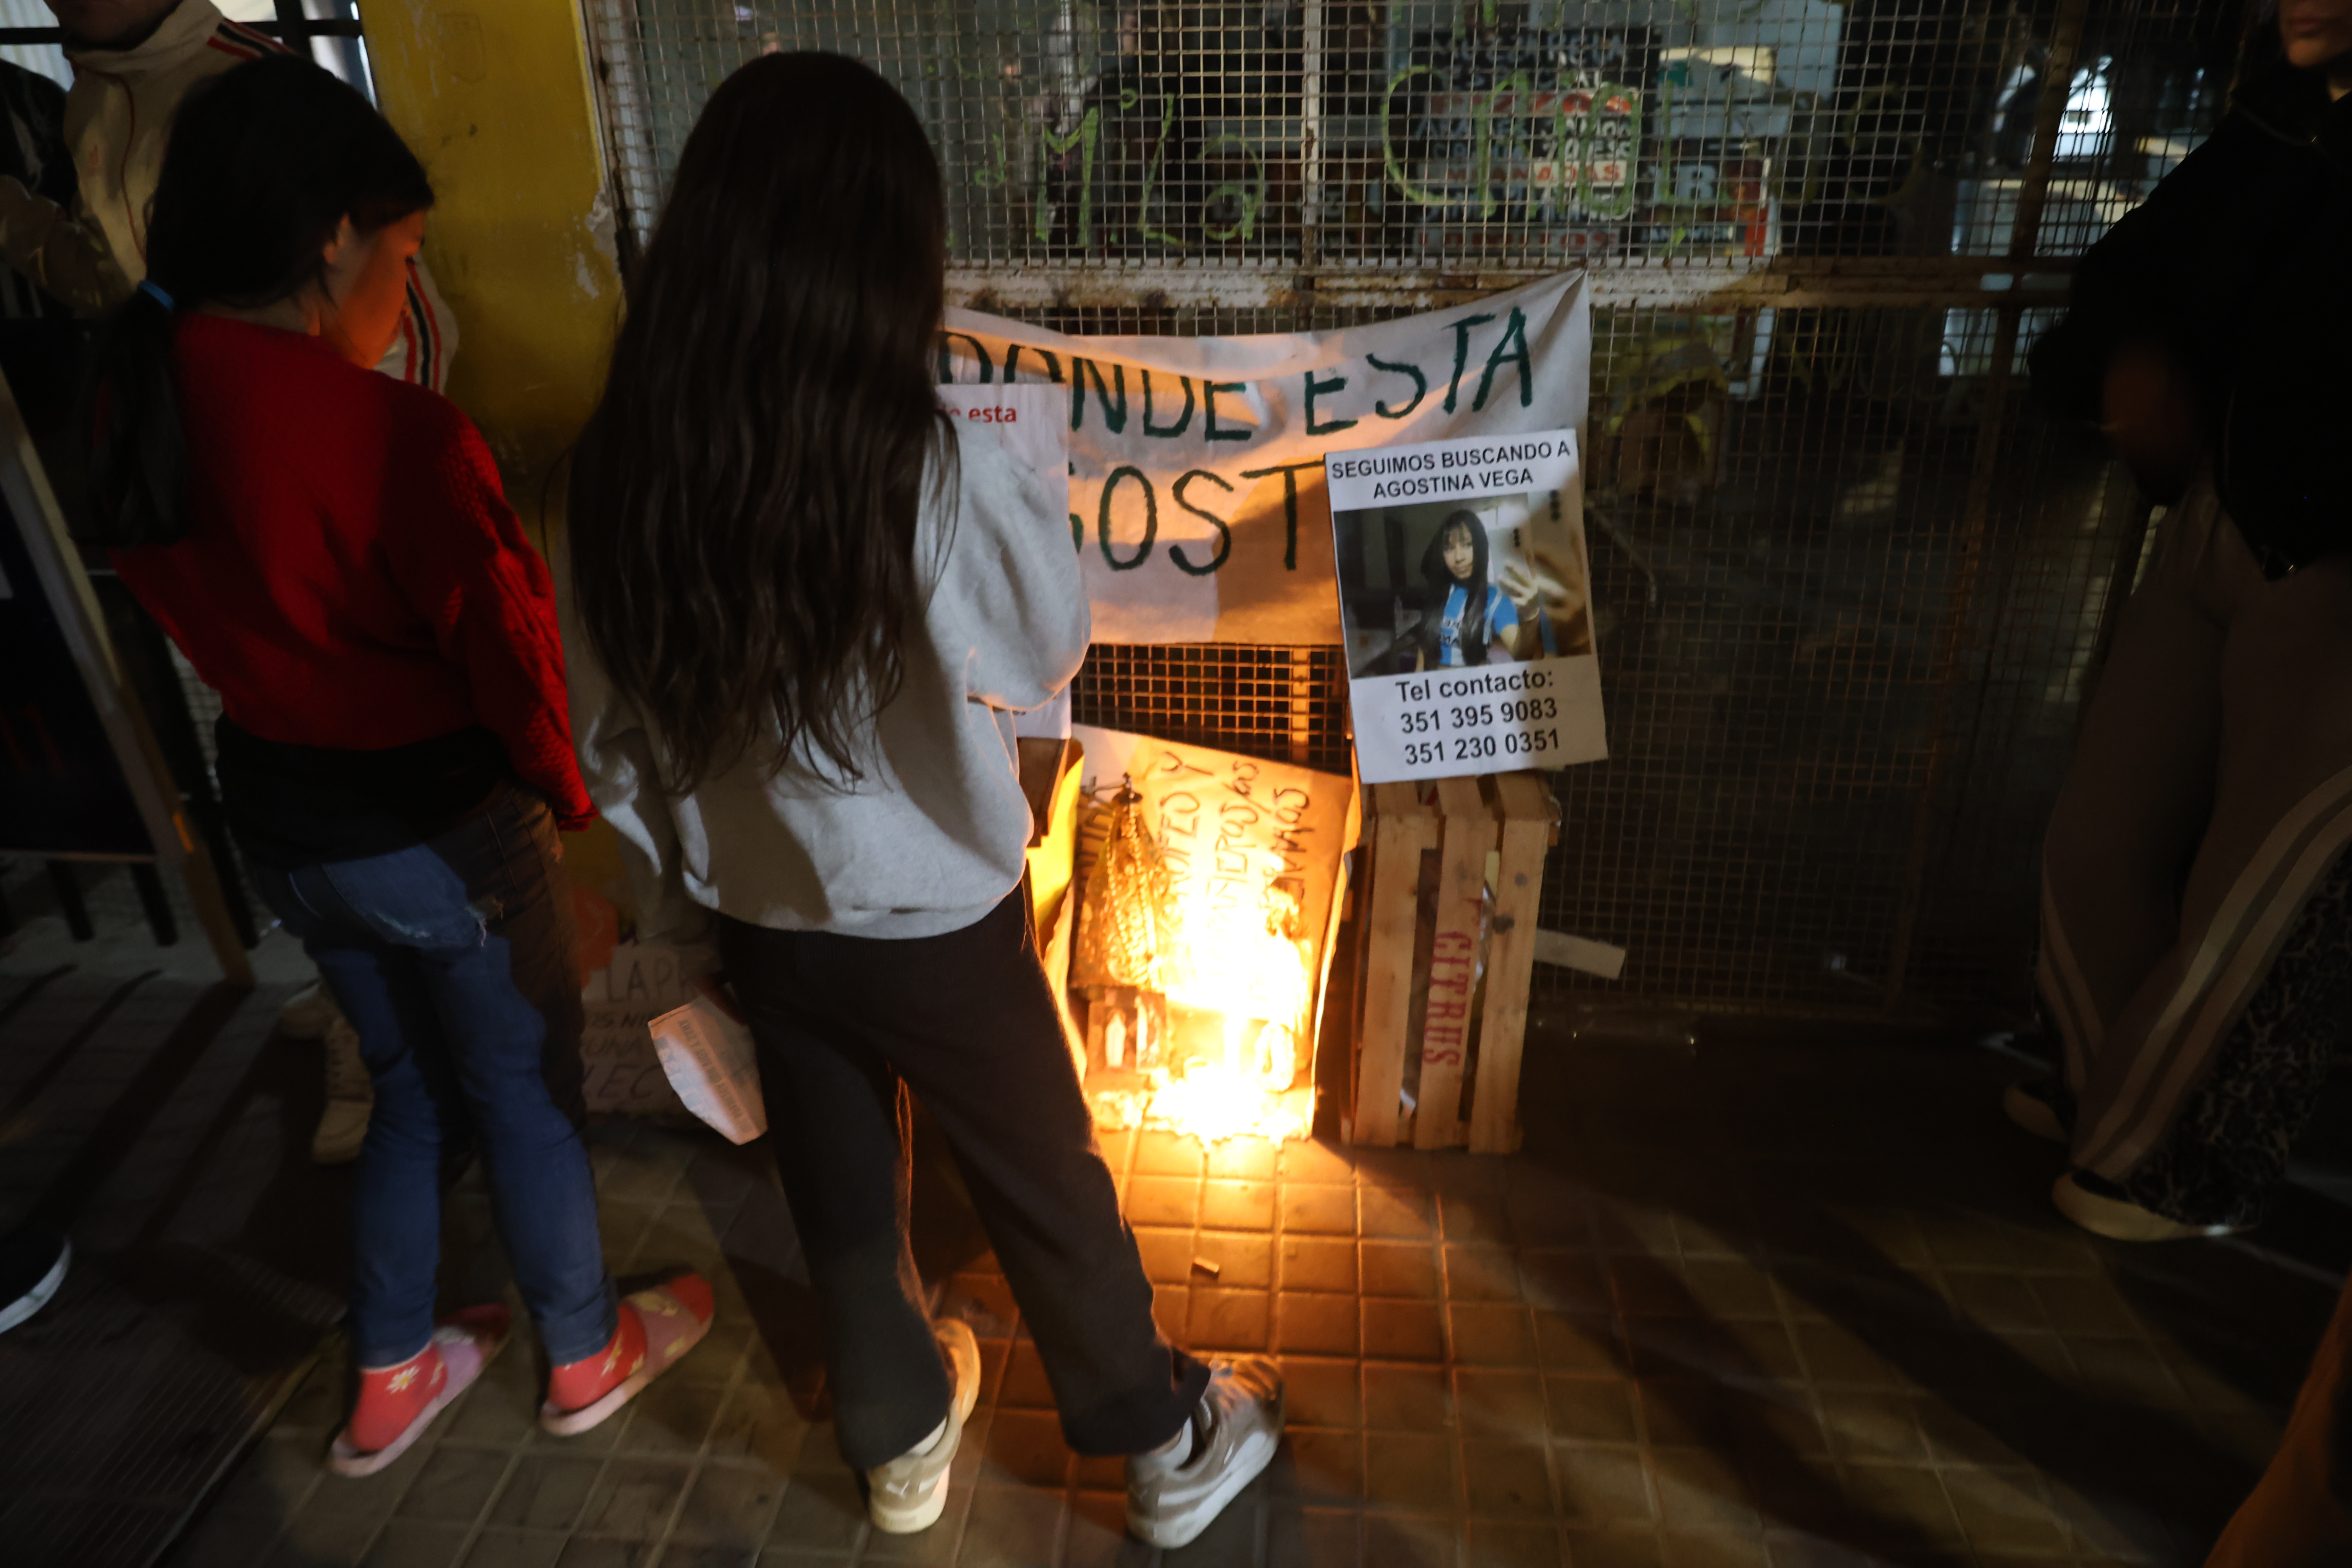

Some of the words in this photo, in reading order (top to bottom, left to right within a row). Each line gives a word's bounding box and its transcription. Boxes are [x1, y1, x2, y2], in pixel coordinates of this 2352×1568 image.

[1304, 306, 1533, 436] ESTA
[969, 405, 1016, 423] esta
[1332, 453, 1435, 479] SEGUIMOS
[1441, 441, 1551, 468] BUSCANDO
[1557, 440, 1570, 457] A
[1373, 473, 1474, 499] AGOSTINA
[1478, 467, 1534, 488] VEGA
[1070, 459, 1326, 576] OST
[1395, 679, 1431, 702] Tel
[1439, 668, 1553, 698] contacto:
[1400, 709, 1441, 734] 351
[1450, 704, 1493, 729] 395
[1501, 697, 1558, 723] 9083
[1405, 740, 1445, 765] 351
[1455, 736, 1496, 760] 230
[1505, 728, 1559, 755] 0351
[1422, 930, 1472, 1067] CITRUS
